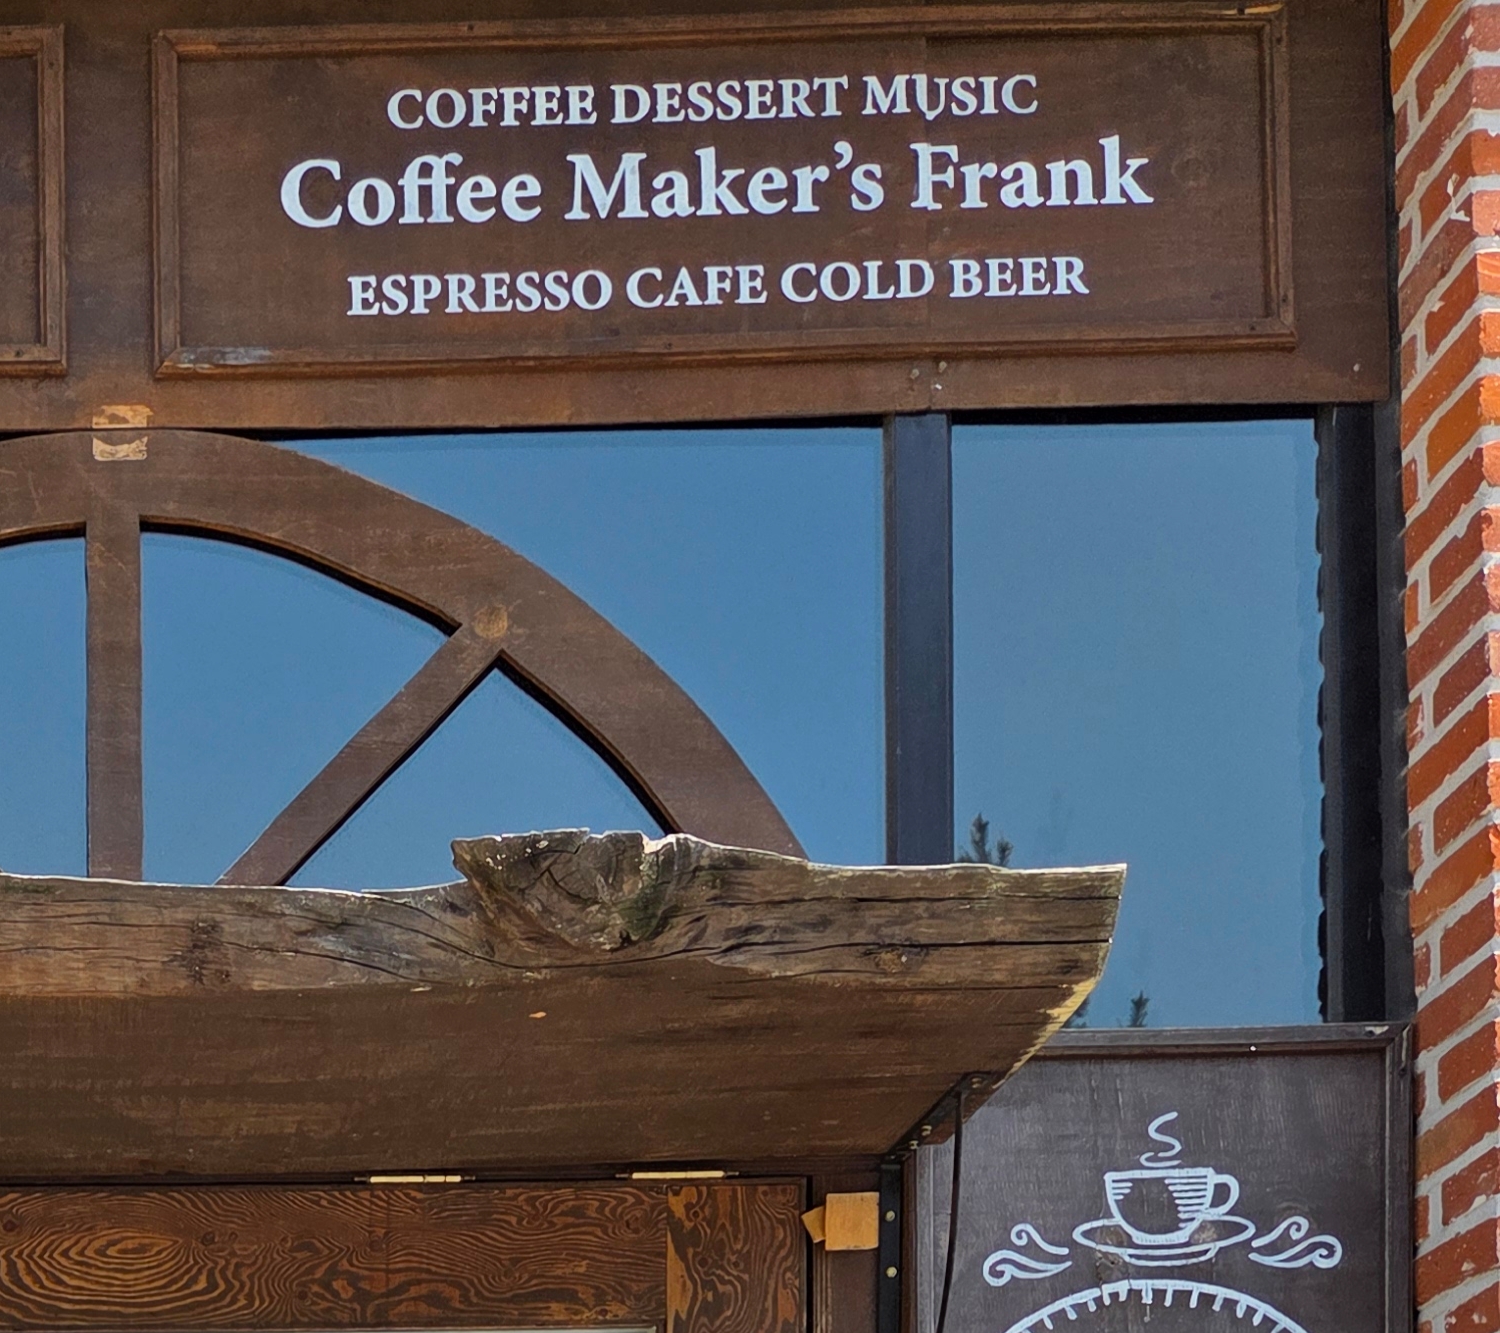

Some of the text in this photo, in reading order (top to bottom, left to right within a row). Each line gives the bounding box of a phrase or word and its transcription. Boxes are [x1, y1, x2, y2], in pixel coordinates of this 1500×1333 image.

[388, 73, 1038, 130] COFFEE DESSERT MUSIC
[281, 134, 1154, 229] Coffee Maker's Frank
[347, 256, 1090, 316] ESPRESSO CAFE COLD BEER
